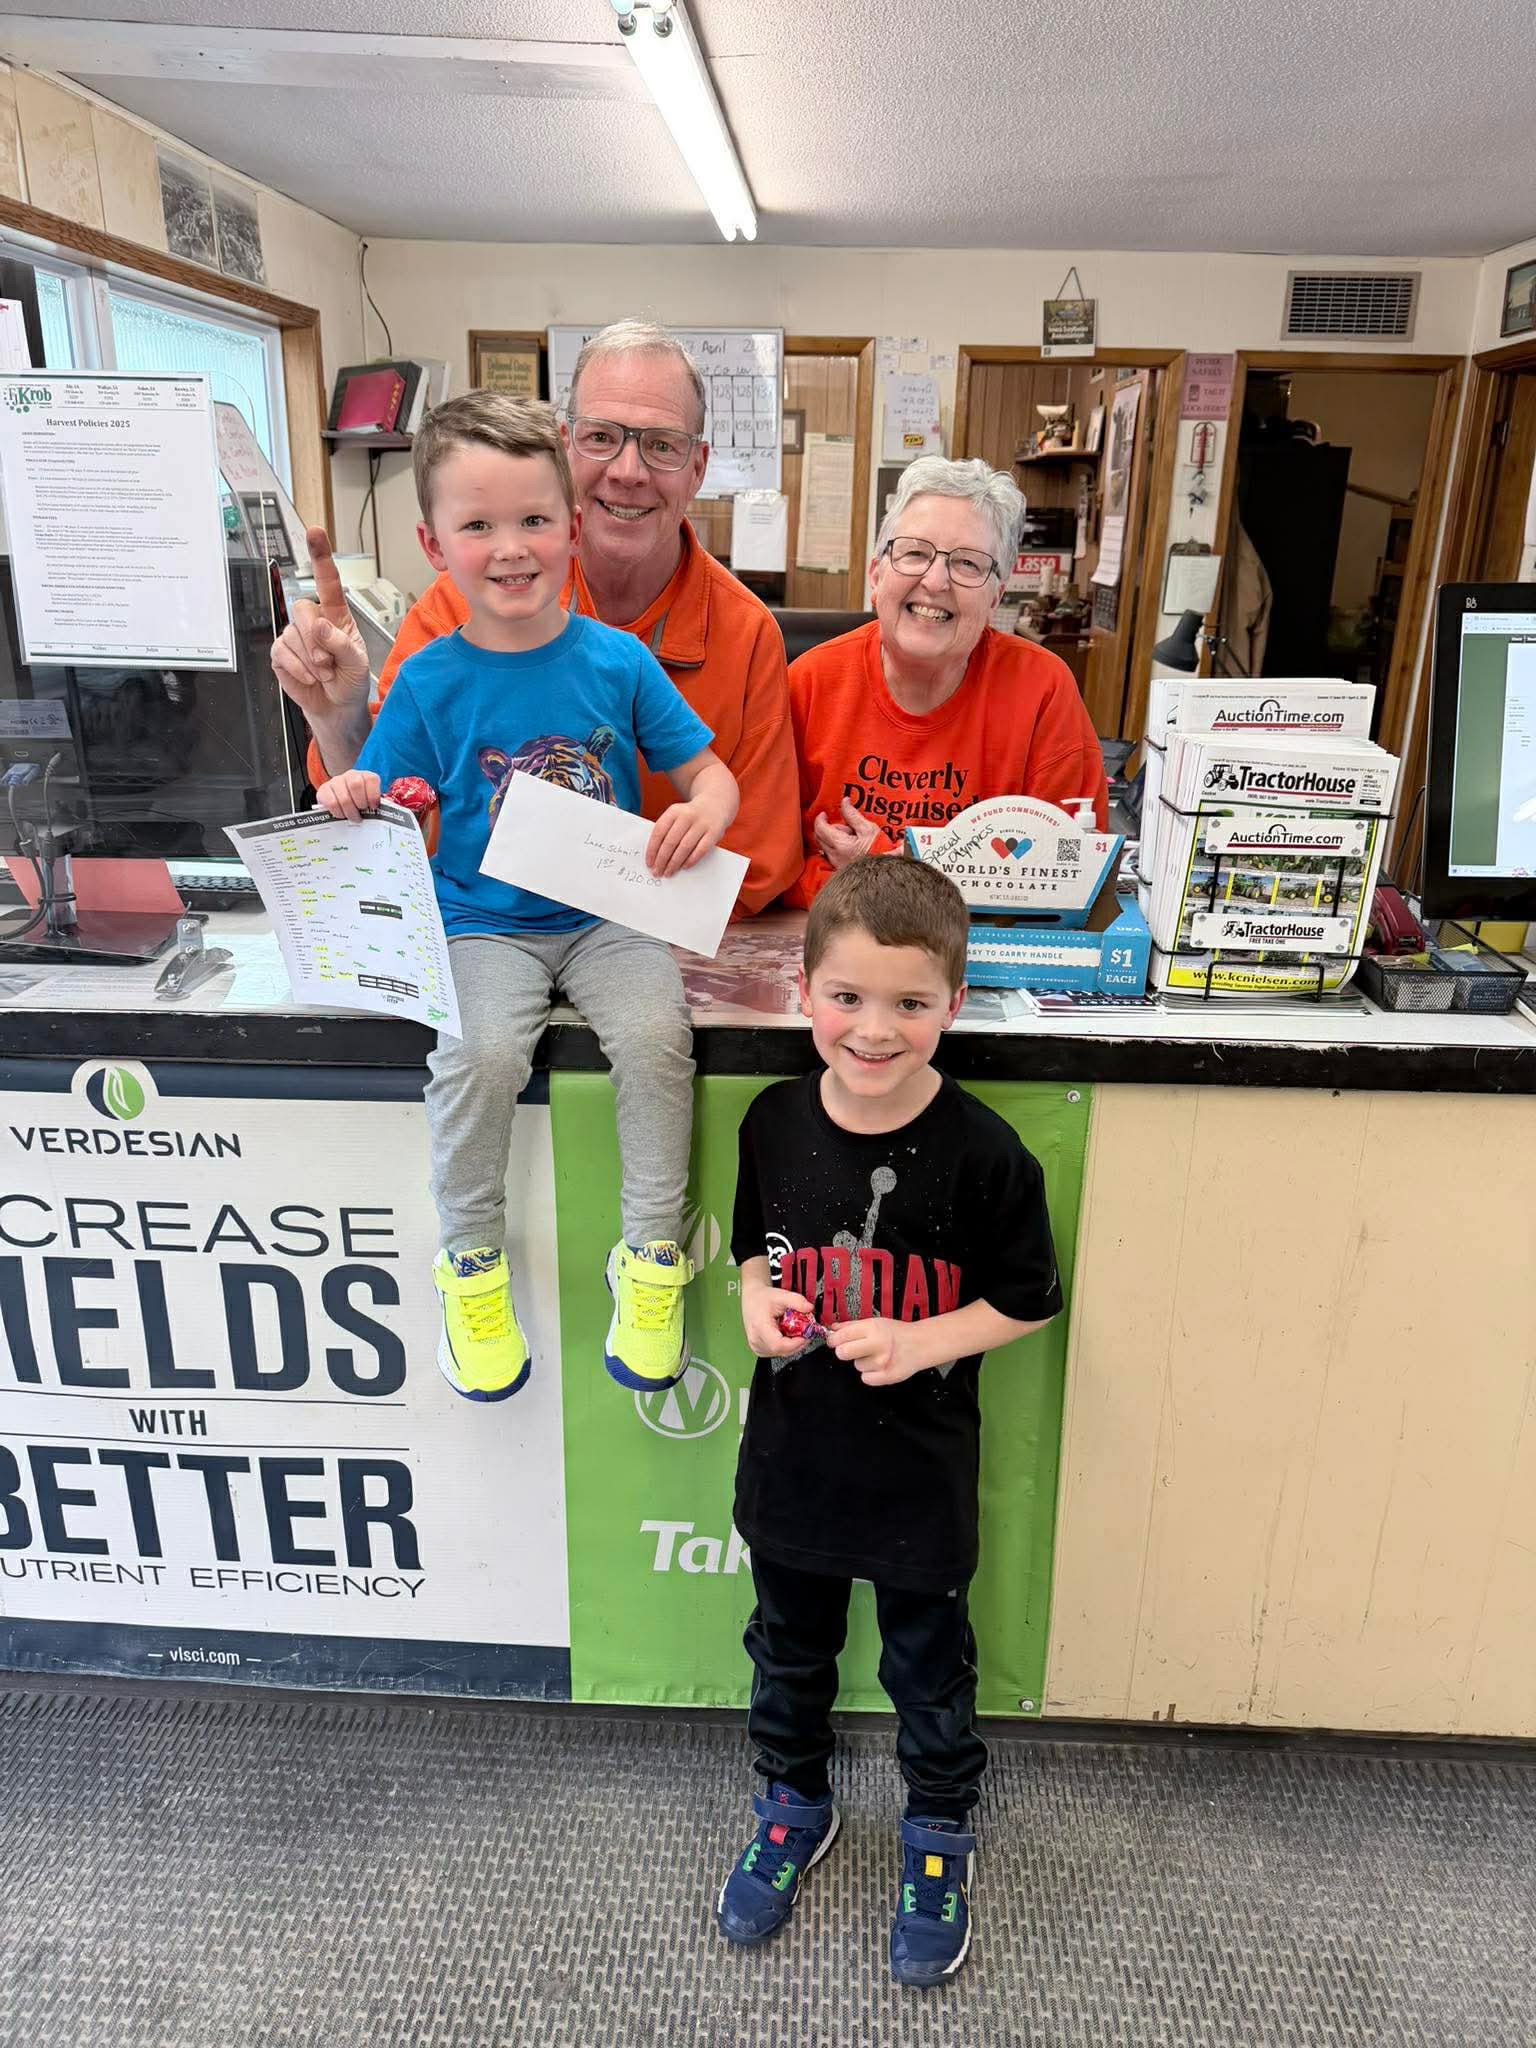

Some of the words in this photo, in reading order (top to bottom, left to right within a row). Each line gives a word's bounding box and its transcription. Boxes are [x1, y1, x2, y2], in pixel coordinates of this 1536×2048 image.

[702, 339, 727, 354] April
[17, 387, 52, 405] Krob
[46, 418, 77, 427] Harvest
[78, 419, 109, 428] Policies
[1215, 709, 1345, 723] AuctionTime.com
[858, 755, 969, 798] Cleverly
[1239, 765, 1357, 794] TractorHouse
[297, 814, 331, 826] College
[971, 814, 982, 825] WE
[983, 807, 1003, 819] FUND
[920, 834, 932, 846] $1
[1230, 831, 1344, 845] AuctionTime.com
[1095, 841, 1108, 853] $1
[942, 863, 1011, 876] WORLD'S
[1021, 867, 1080, 879] FINEST
[961, 879, 1058, 891] CHOCOLATE
[1244, 921, 1325, 938] TractorHouse
[1000, 950, 1028, 958] CARRY
[1030, 952, 1063, 960] HANDLE
[1109, 947, 1133, 969] $1
[1105, 974, 1138, 985] EACH
[9, 1126, 242, 1159] VERDESIAN
[0, 1194, 400, 1259] CREASE
[129, 1408, 208, 1437] WITH
[0, 1556, 167, 1587] UTRIENT
[190, 1567, 426, 1600] EFFICIENCY
[169, 1646, 241, 1667] vlsci.com
